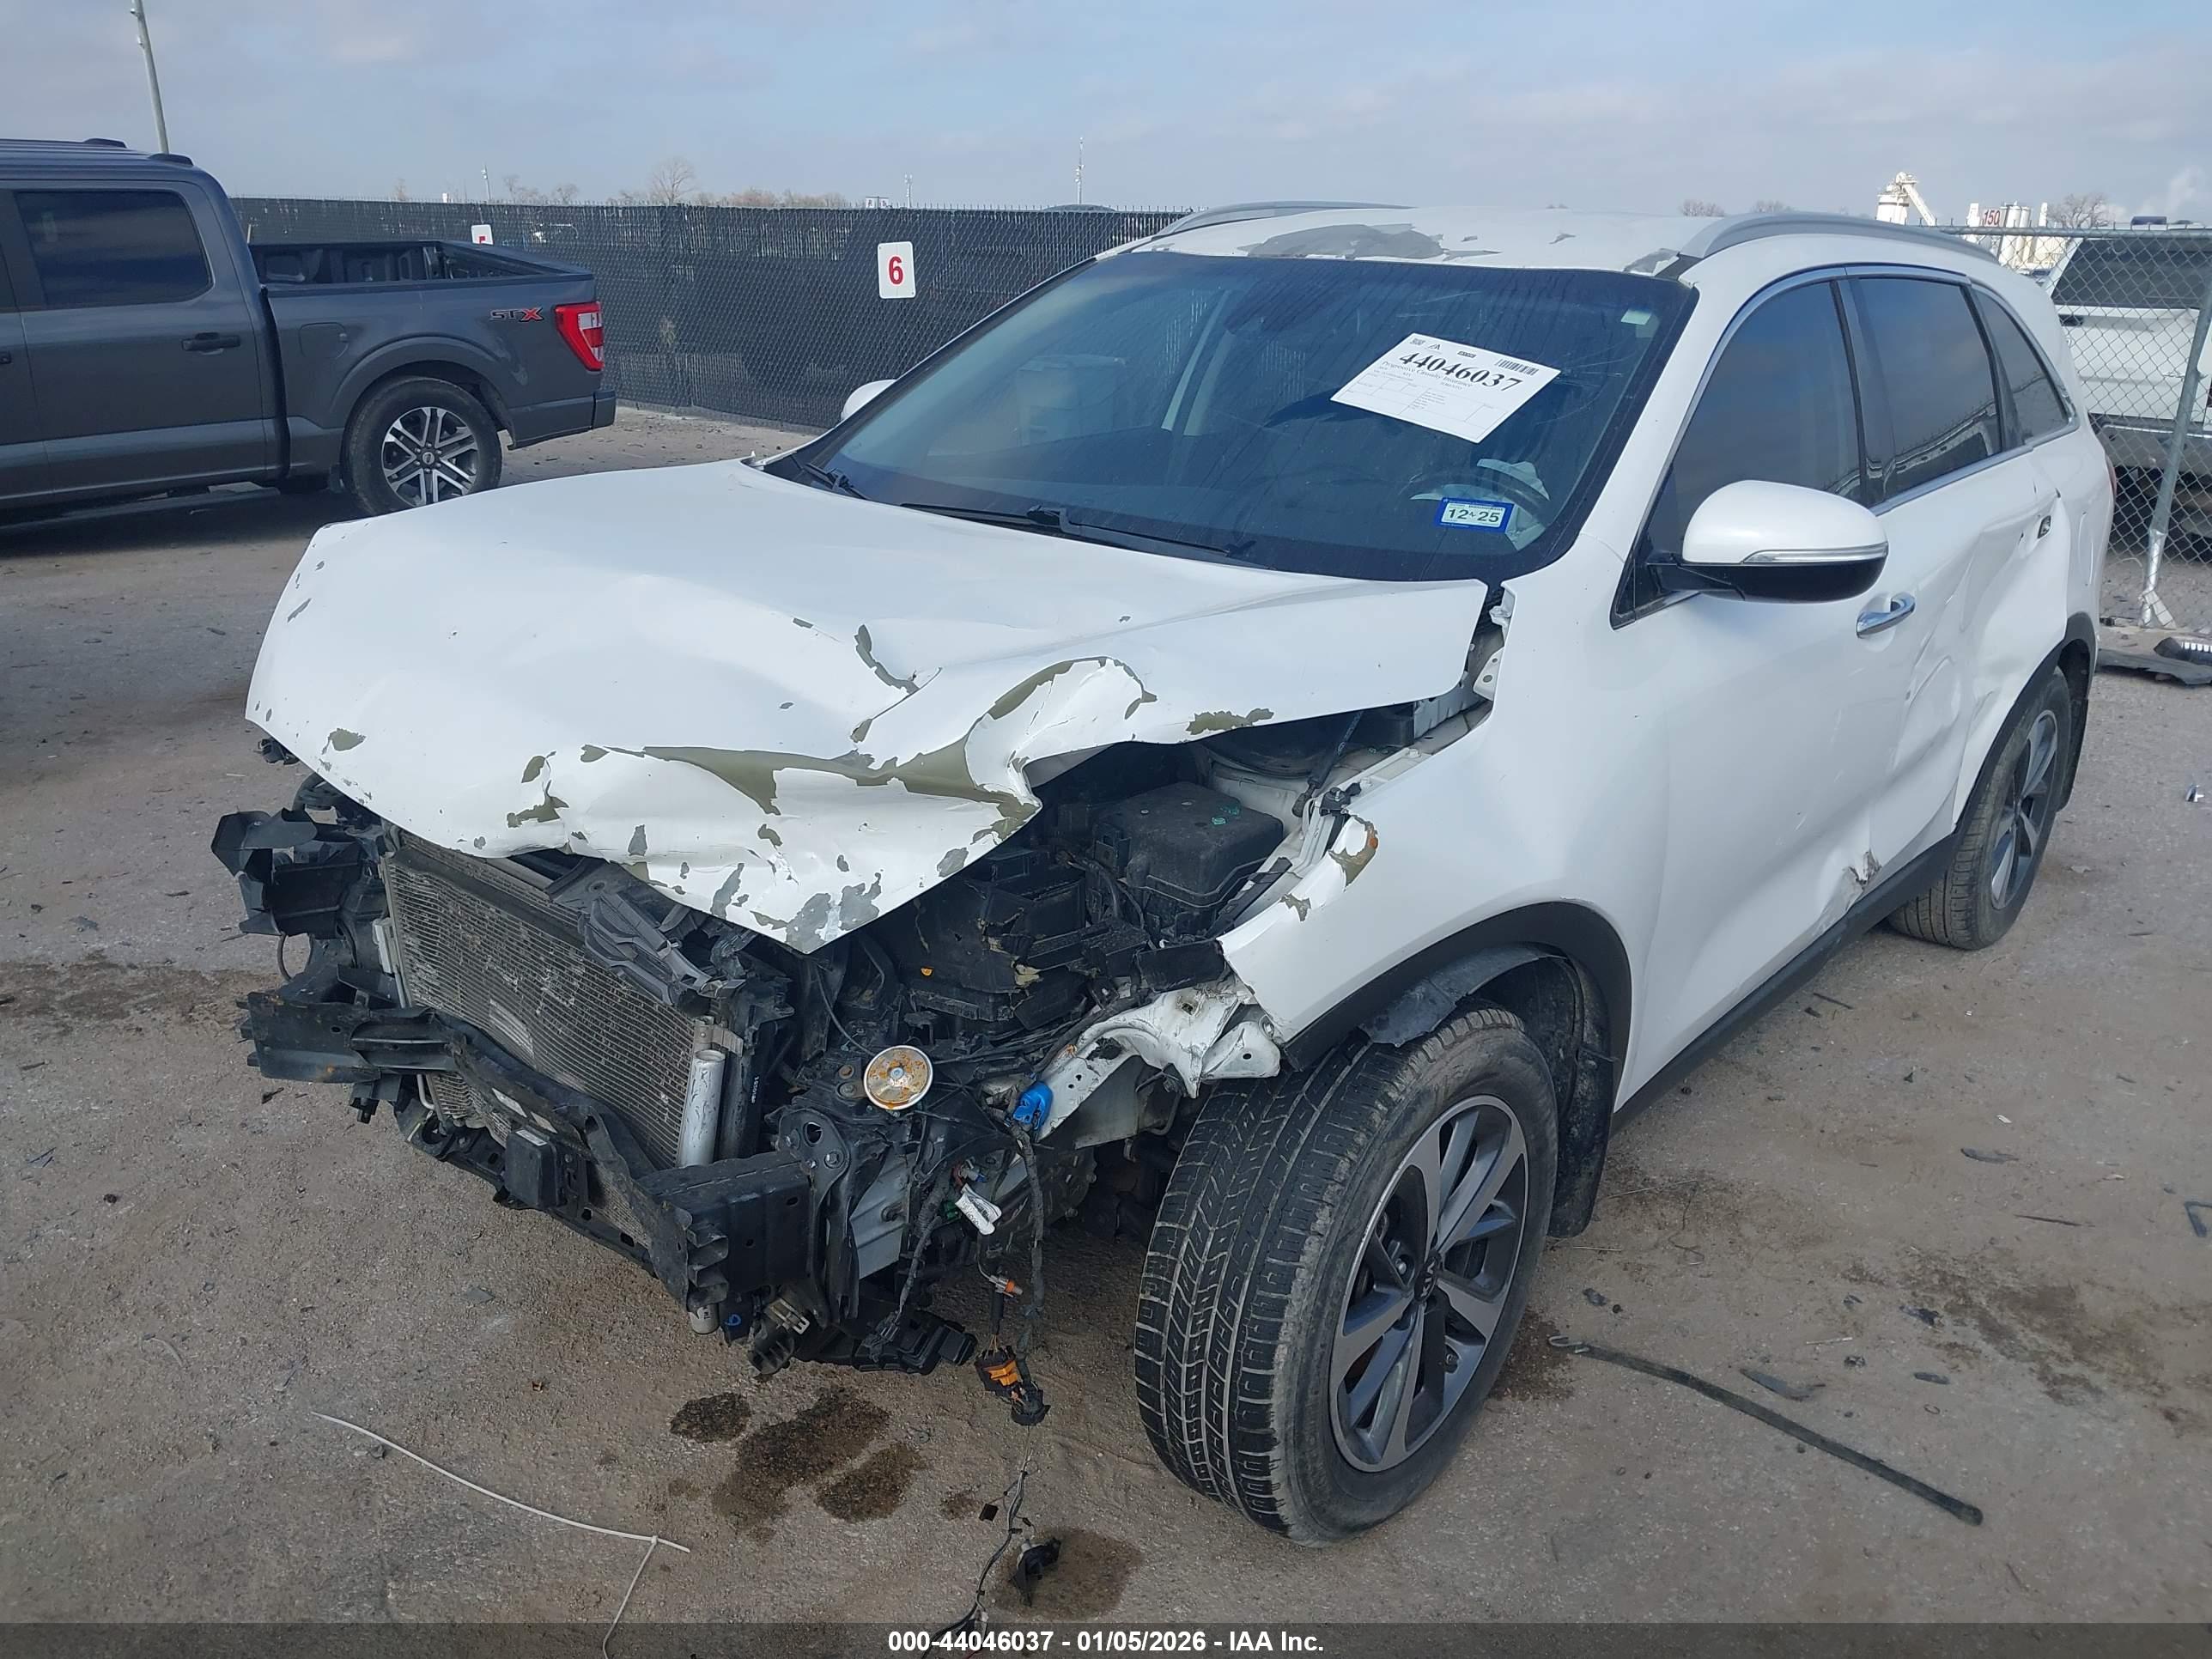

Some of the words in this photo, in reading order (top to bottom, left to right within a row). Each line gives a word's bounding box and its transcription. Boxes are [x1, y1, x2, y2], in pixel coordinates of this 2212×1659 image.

[1984, 209, 2001, 226] 150
[888, 256, 904, 285] 6
[489, 307, 544, 322] STX
[1400, 352, 1523, 392] 44046037
[1449, 508, 1469, 520] 12
[1477, 511, 1501, 523] 25
